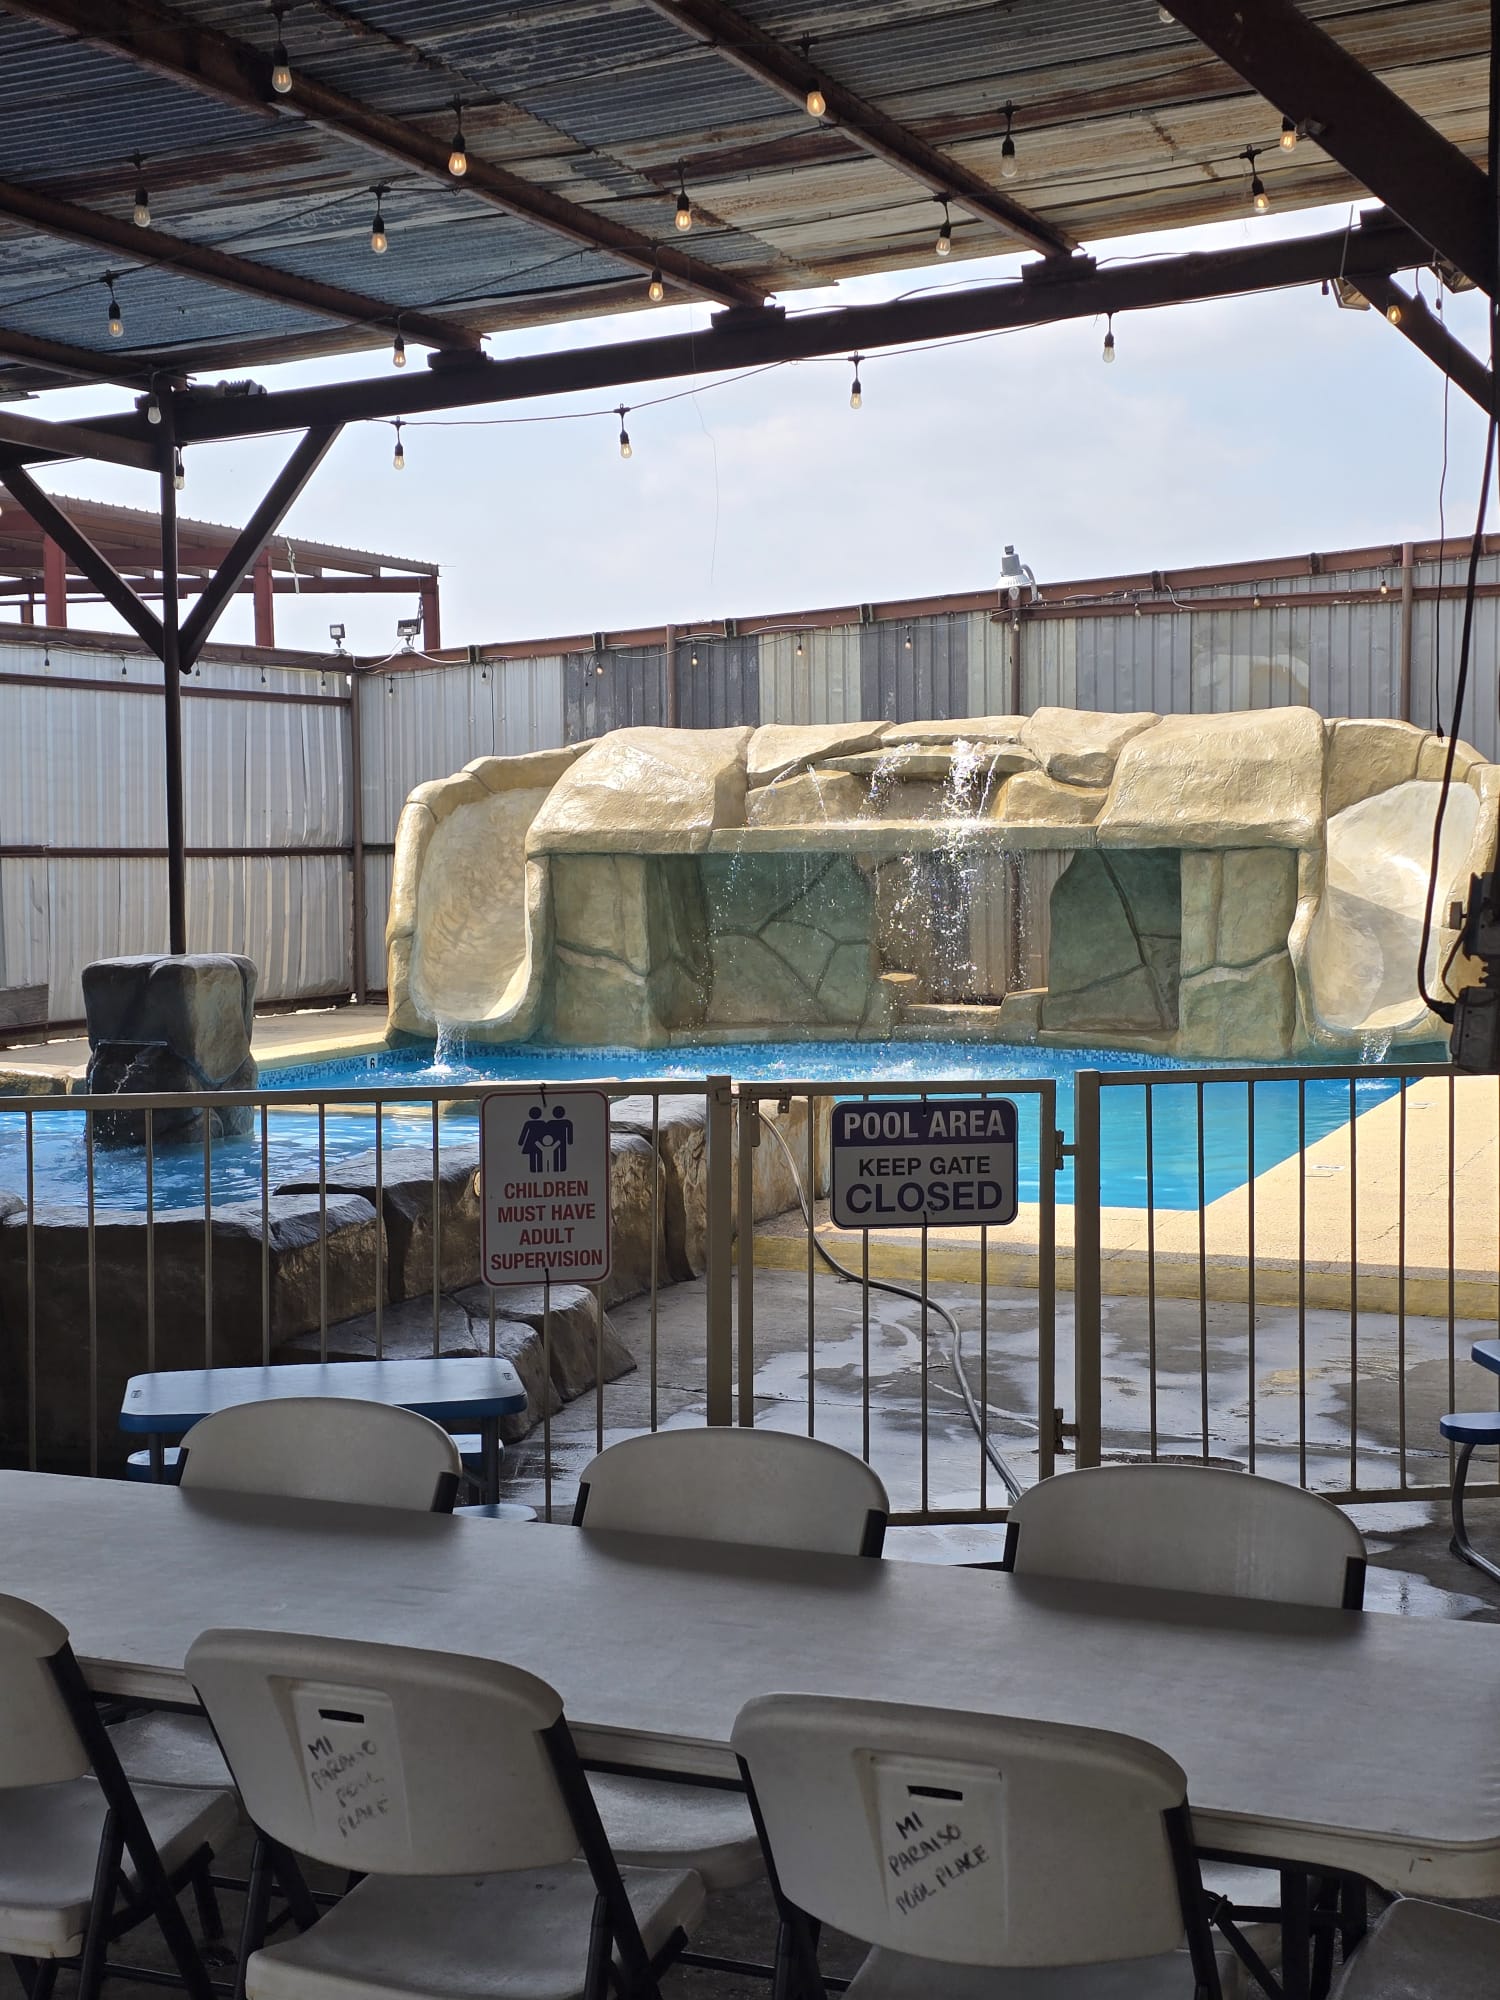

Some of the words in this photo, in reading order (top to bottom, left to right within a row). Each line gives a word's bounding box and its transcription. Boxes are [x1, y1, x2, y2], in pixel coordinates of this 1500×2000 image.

[844, 1111, 919, 1140] POOL
[928, 1109, 1006, 1138] AREA
[859, 1158, 921, 1177] KEEP
[930, 1156, 990, 1175] GATE
[504, 1181, 588, 1199] CHILDREN
[846, 1181, 1002, 1213] CLOSED
[498, 1205, 546, 1223] MUST
[551, 1203, 595, 1221] HAVE
[519, 1227, 574, 1246] ADULT
[491, 1249, 602, 1270] SUPERVISION
[307, 1736, 334, 1760] MI
[896, 1811, 924, 1840] MI
[888, 1823, 962, 1877] PARAISO
[896, 1882, 937, 1915] POOL
[936, 1844, 989, 1888] PLACE
